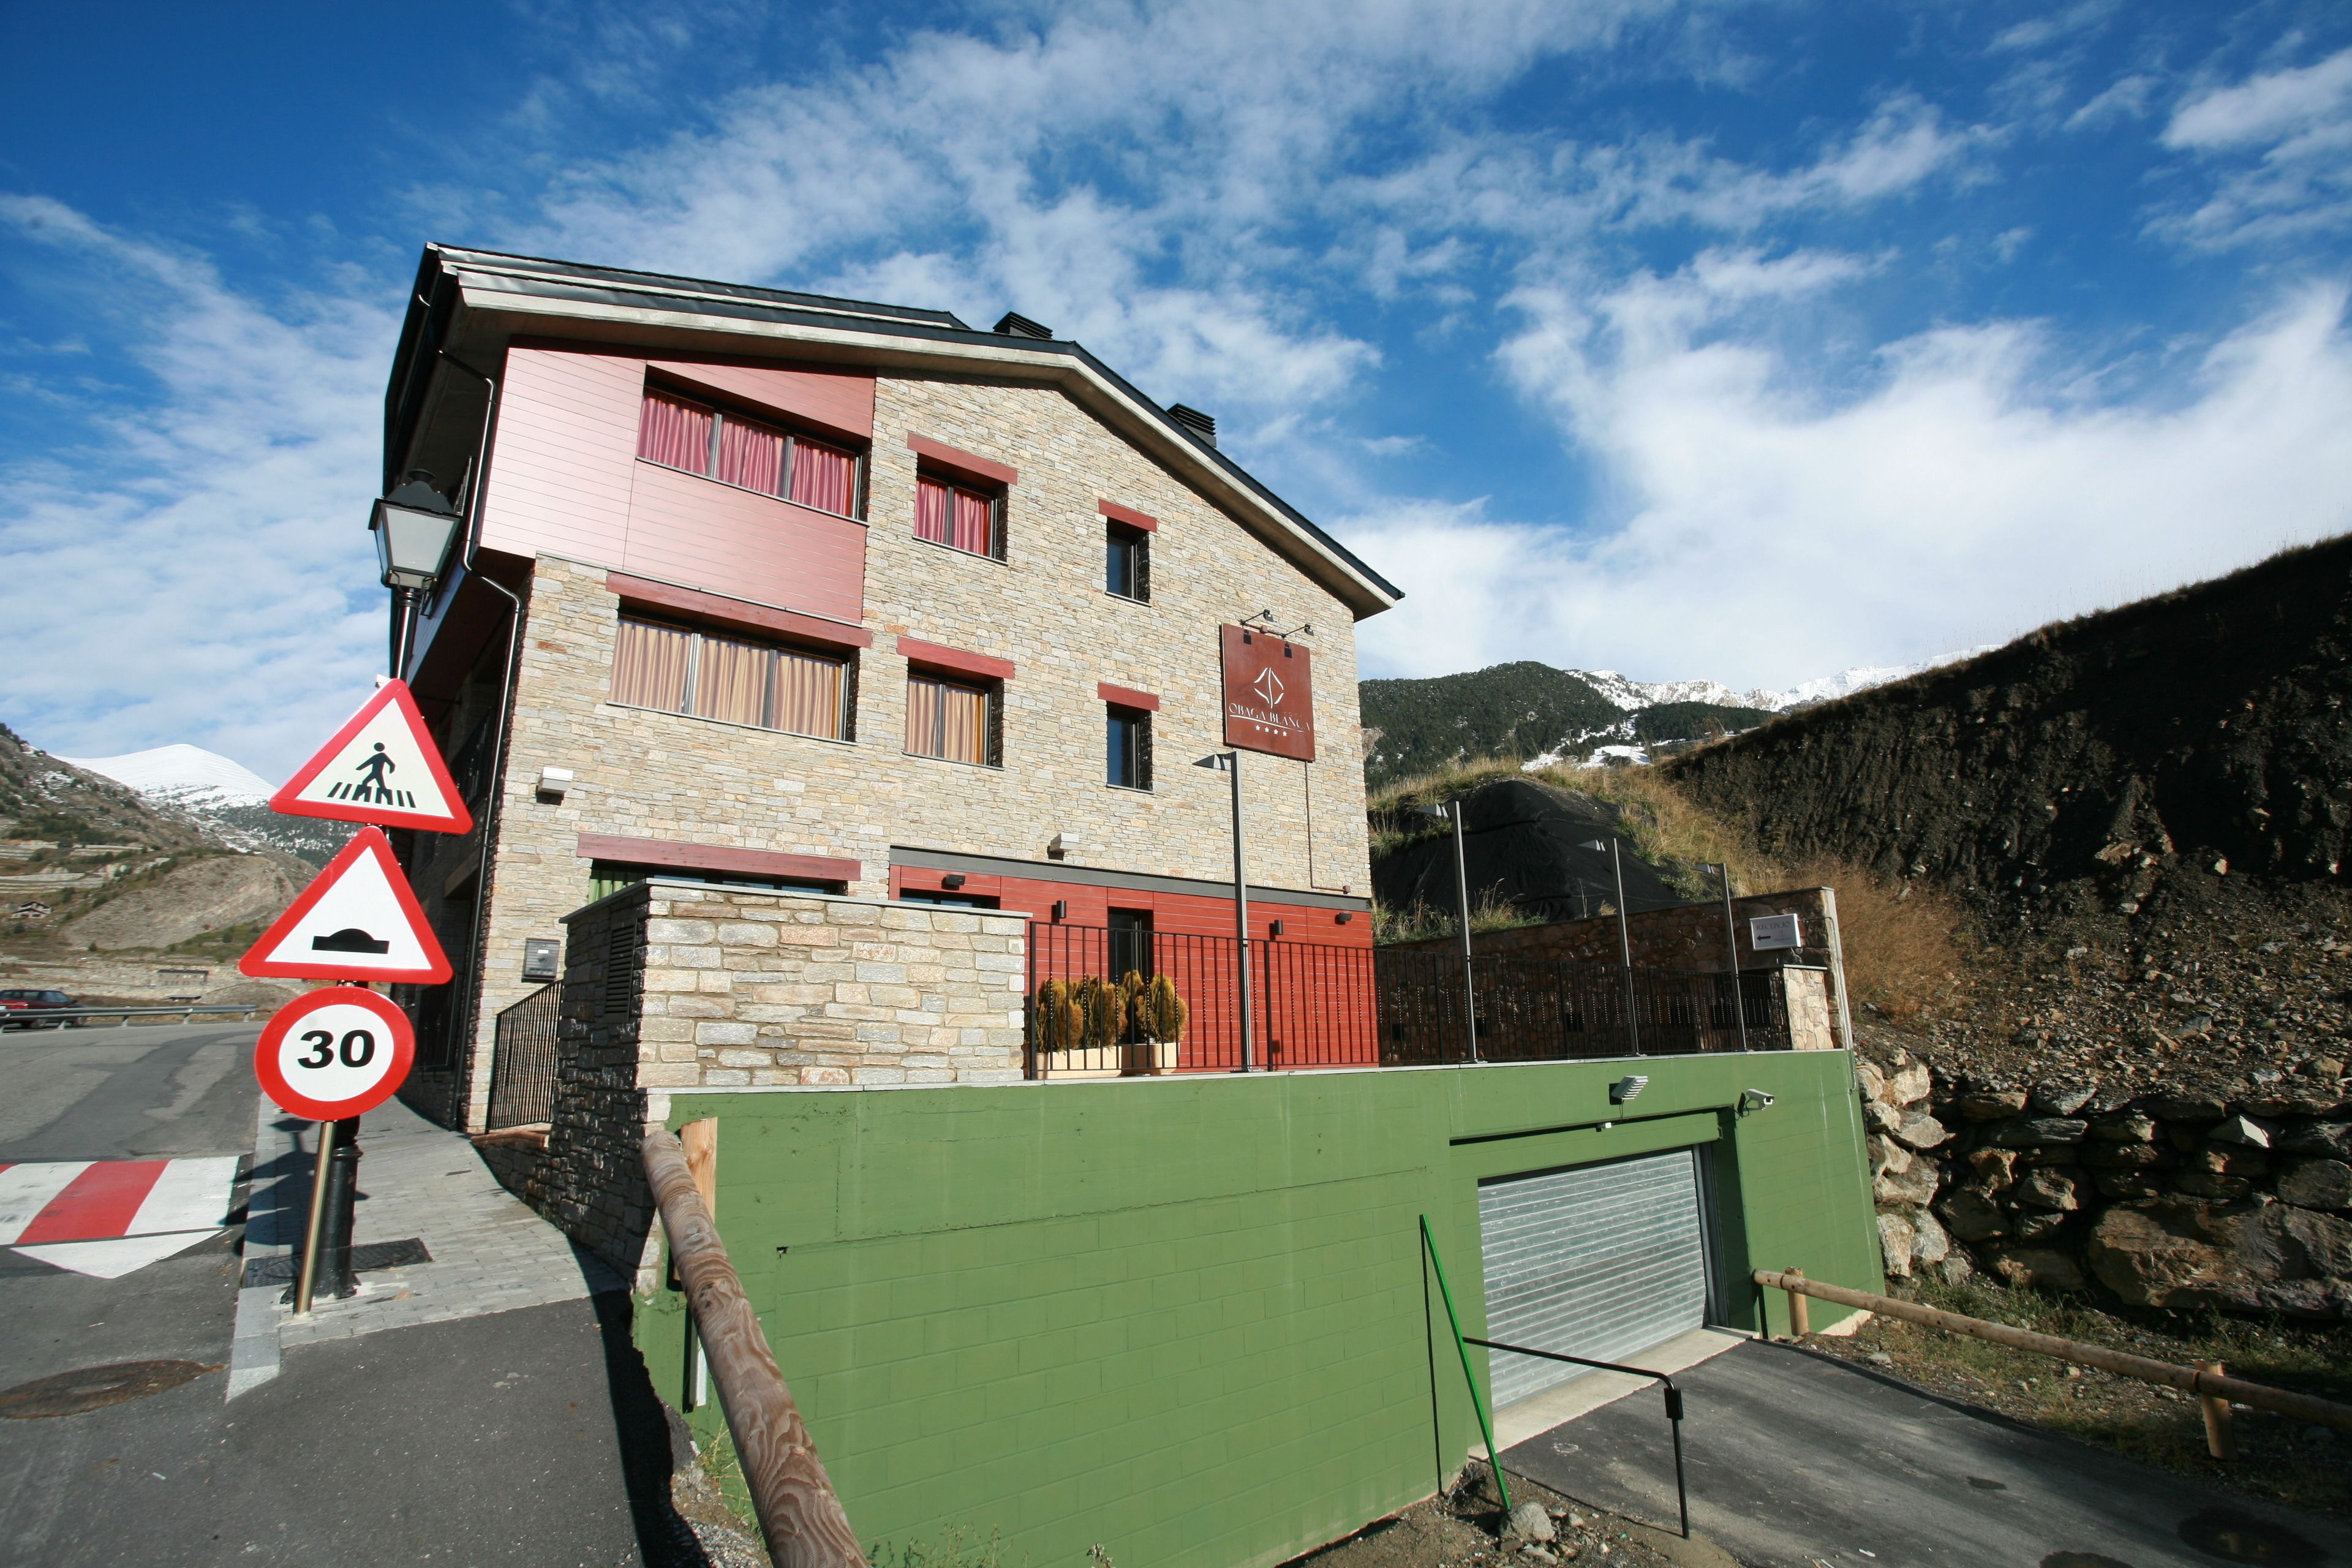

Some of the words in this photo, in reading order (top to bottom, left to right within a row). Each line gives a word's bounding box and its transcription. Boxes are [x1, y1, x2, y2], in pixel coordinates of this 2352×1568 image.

[1229, 703, 1266, 721] OBAGA
[1270, 712, 1310, 731] BLANCA
[298, 1029, 375, 1069] 30
